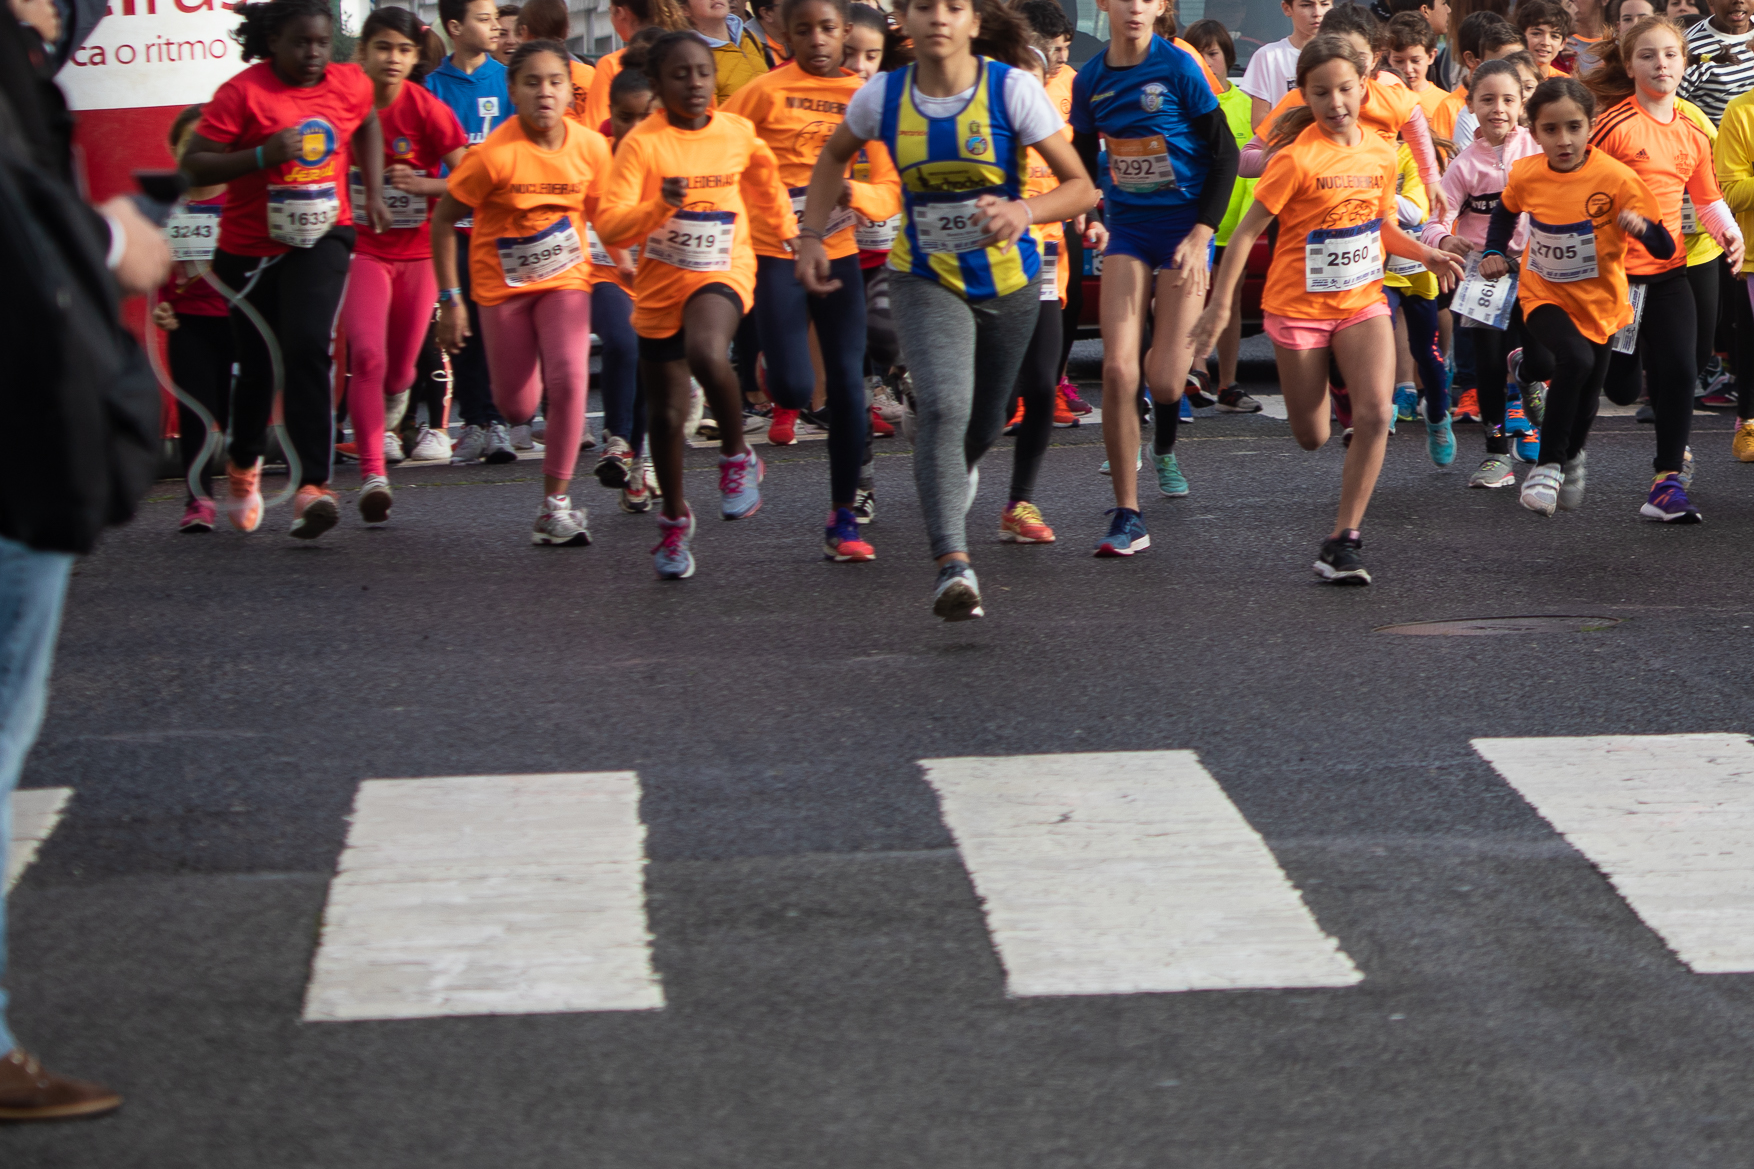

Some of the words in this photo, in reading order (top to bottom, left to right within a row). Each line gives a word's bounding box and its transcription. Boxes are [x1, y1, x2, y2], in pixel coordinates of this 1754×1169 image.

[115, 44, 136, 65] o
[145, 34, 227, 63] ritmo
[1114, 159, 1156, 176] 4292
[287, 210, 328, 227] 1633
[170, 225, 212, 239] 3243
[667, 230, 716, 248] 2219
[517, 243, 562, 267] 2398
[1327, 246, 1369, 266] 2560
[1536, 240, 1577, 260] 2705
